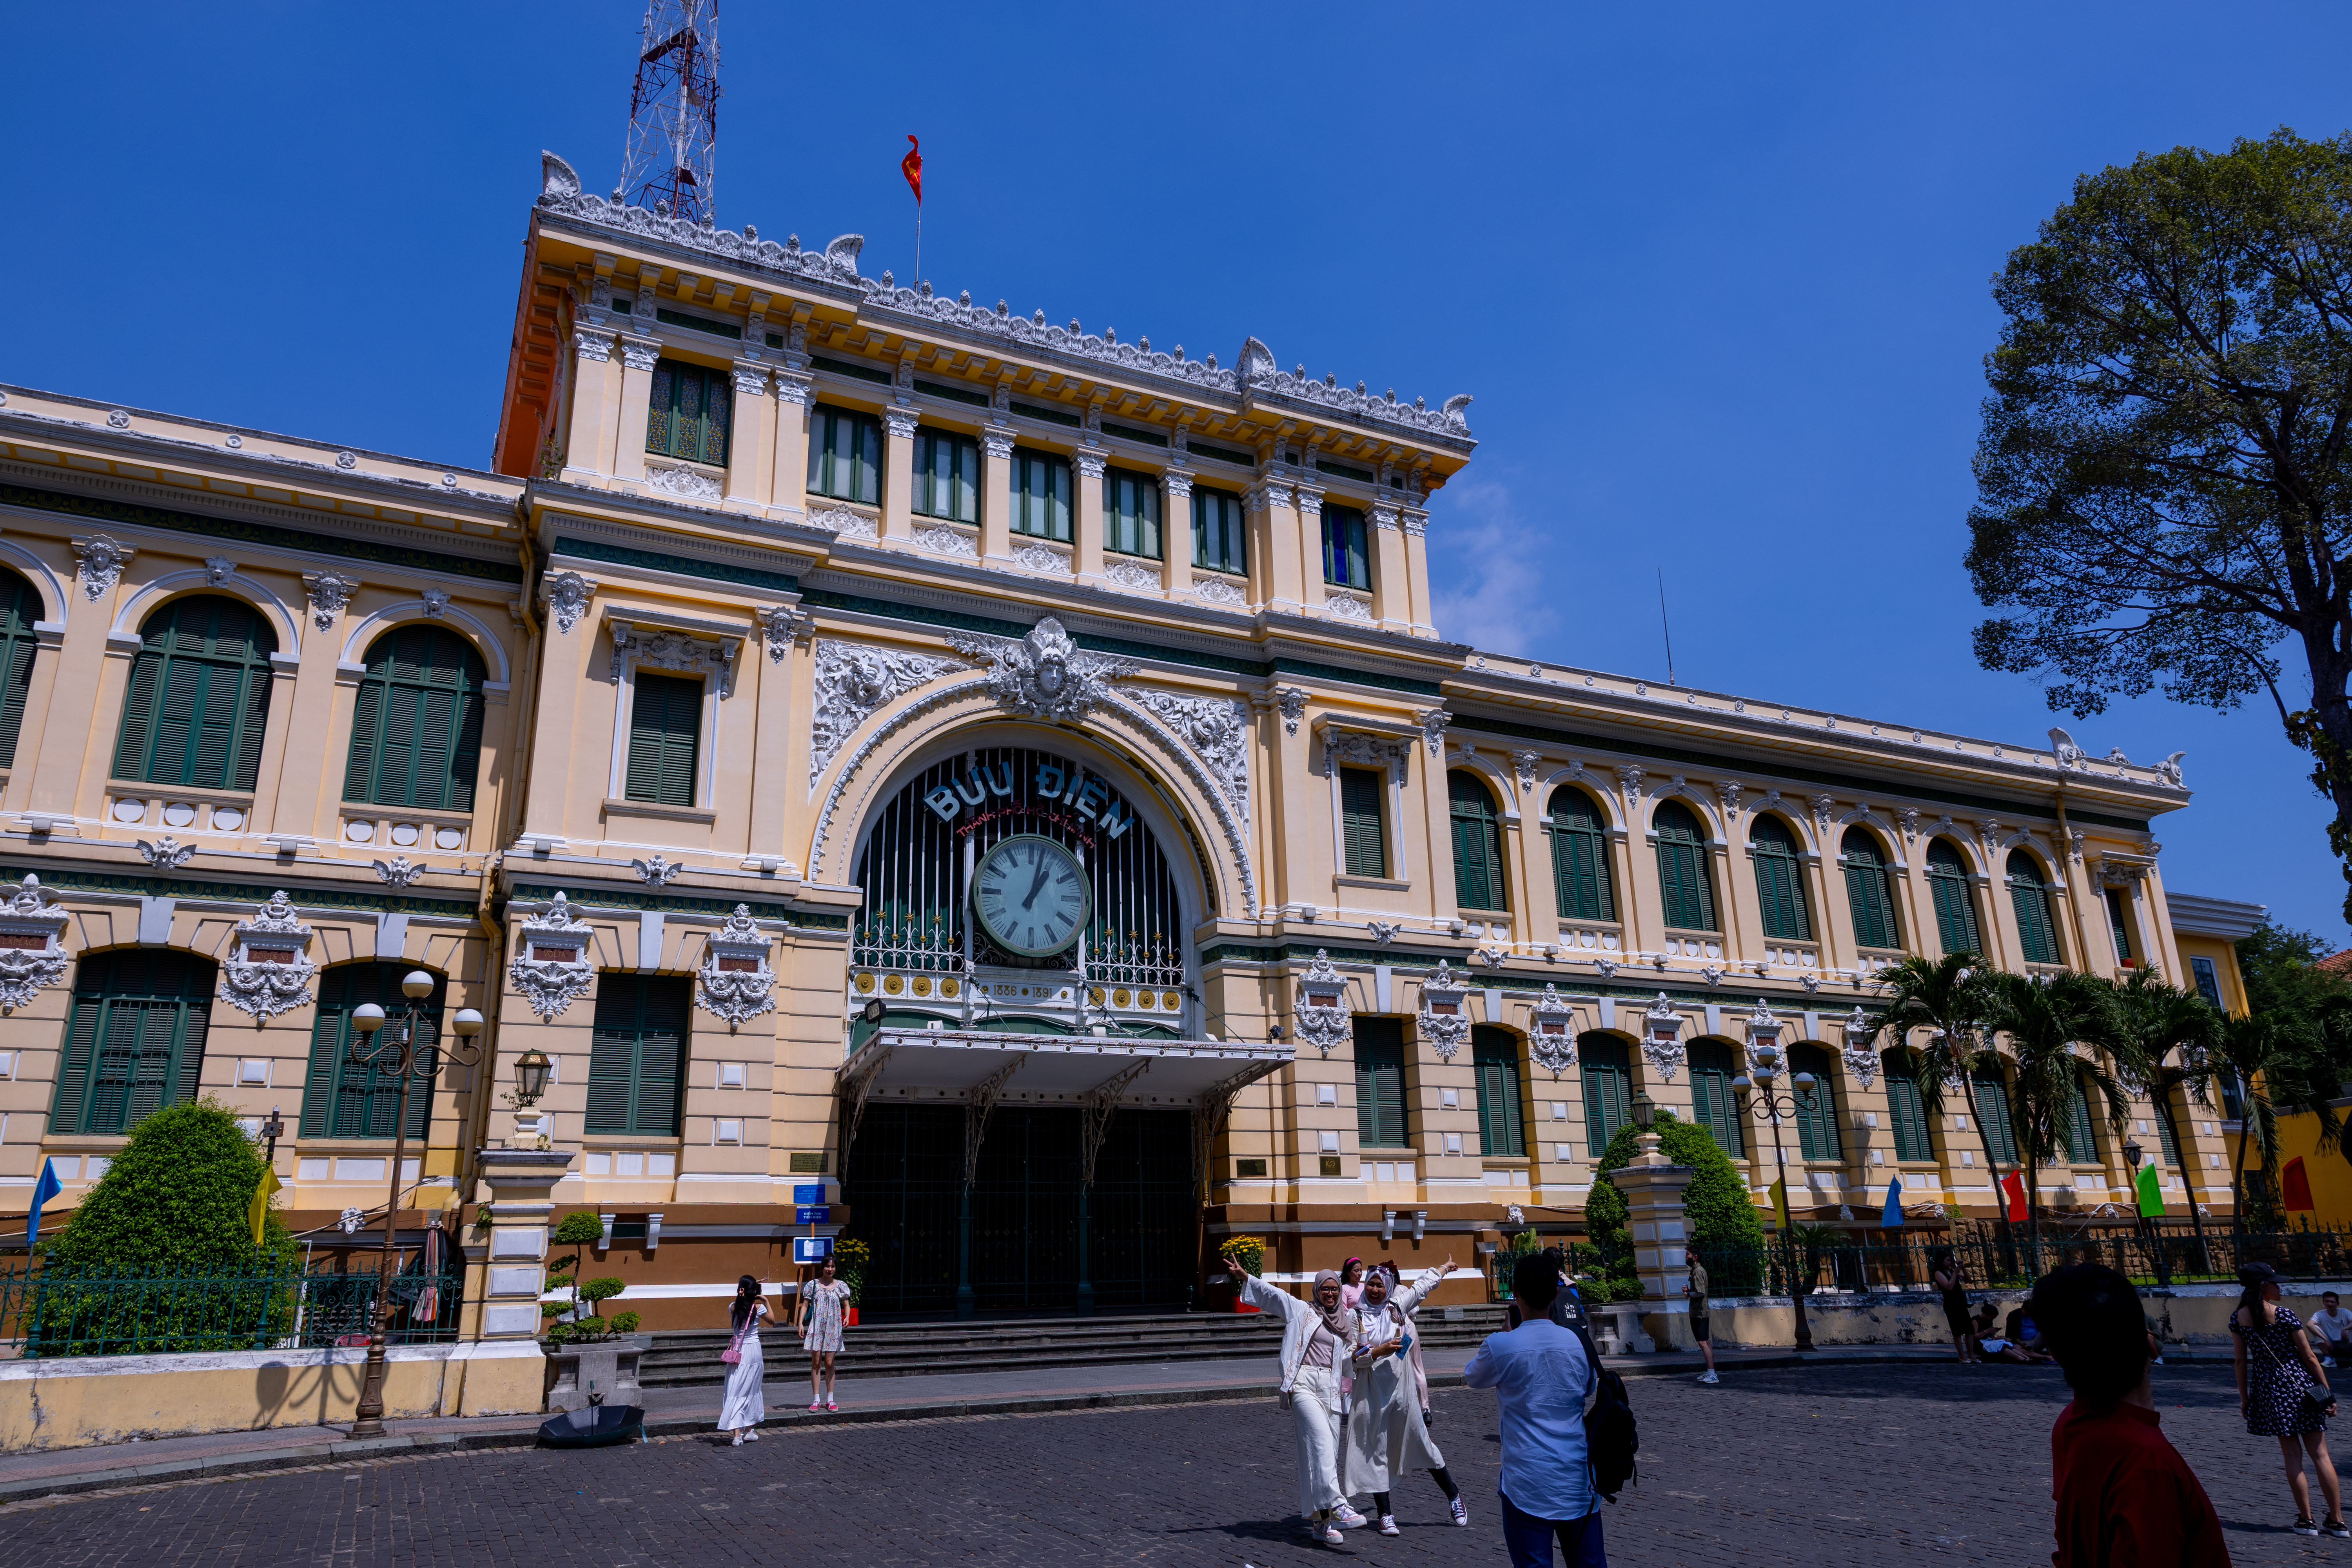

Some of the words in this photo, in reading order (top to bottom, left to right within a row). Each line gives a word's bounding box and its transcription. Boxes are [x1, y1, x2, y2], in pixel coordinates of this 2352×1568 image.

[921, 761, 1013, 822] BƯU
[1034, 763, 1135, 840] ĐIỆN
[955, 810, 996, 838] THÀNH
[997, 799, 1022, 817] PHỐ
[1025, 802, 1045, 816] HỒ
[1047, 812, 1072, 827] CHÍ
[1066, 823, 1096, 849] MINH
[2, 938, 39, 946] LAPLACE
[993, 984, 1017, 996] 1886
[1033, 987, 1052, 999] 1891
